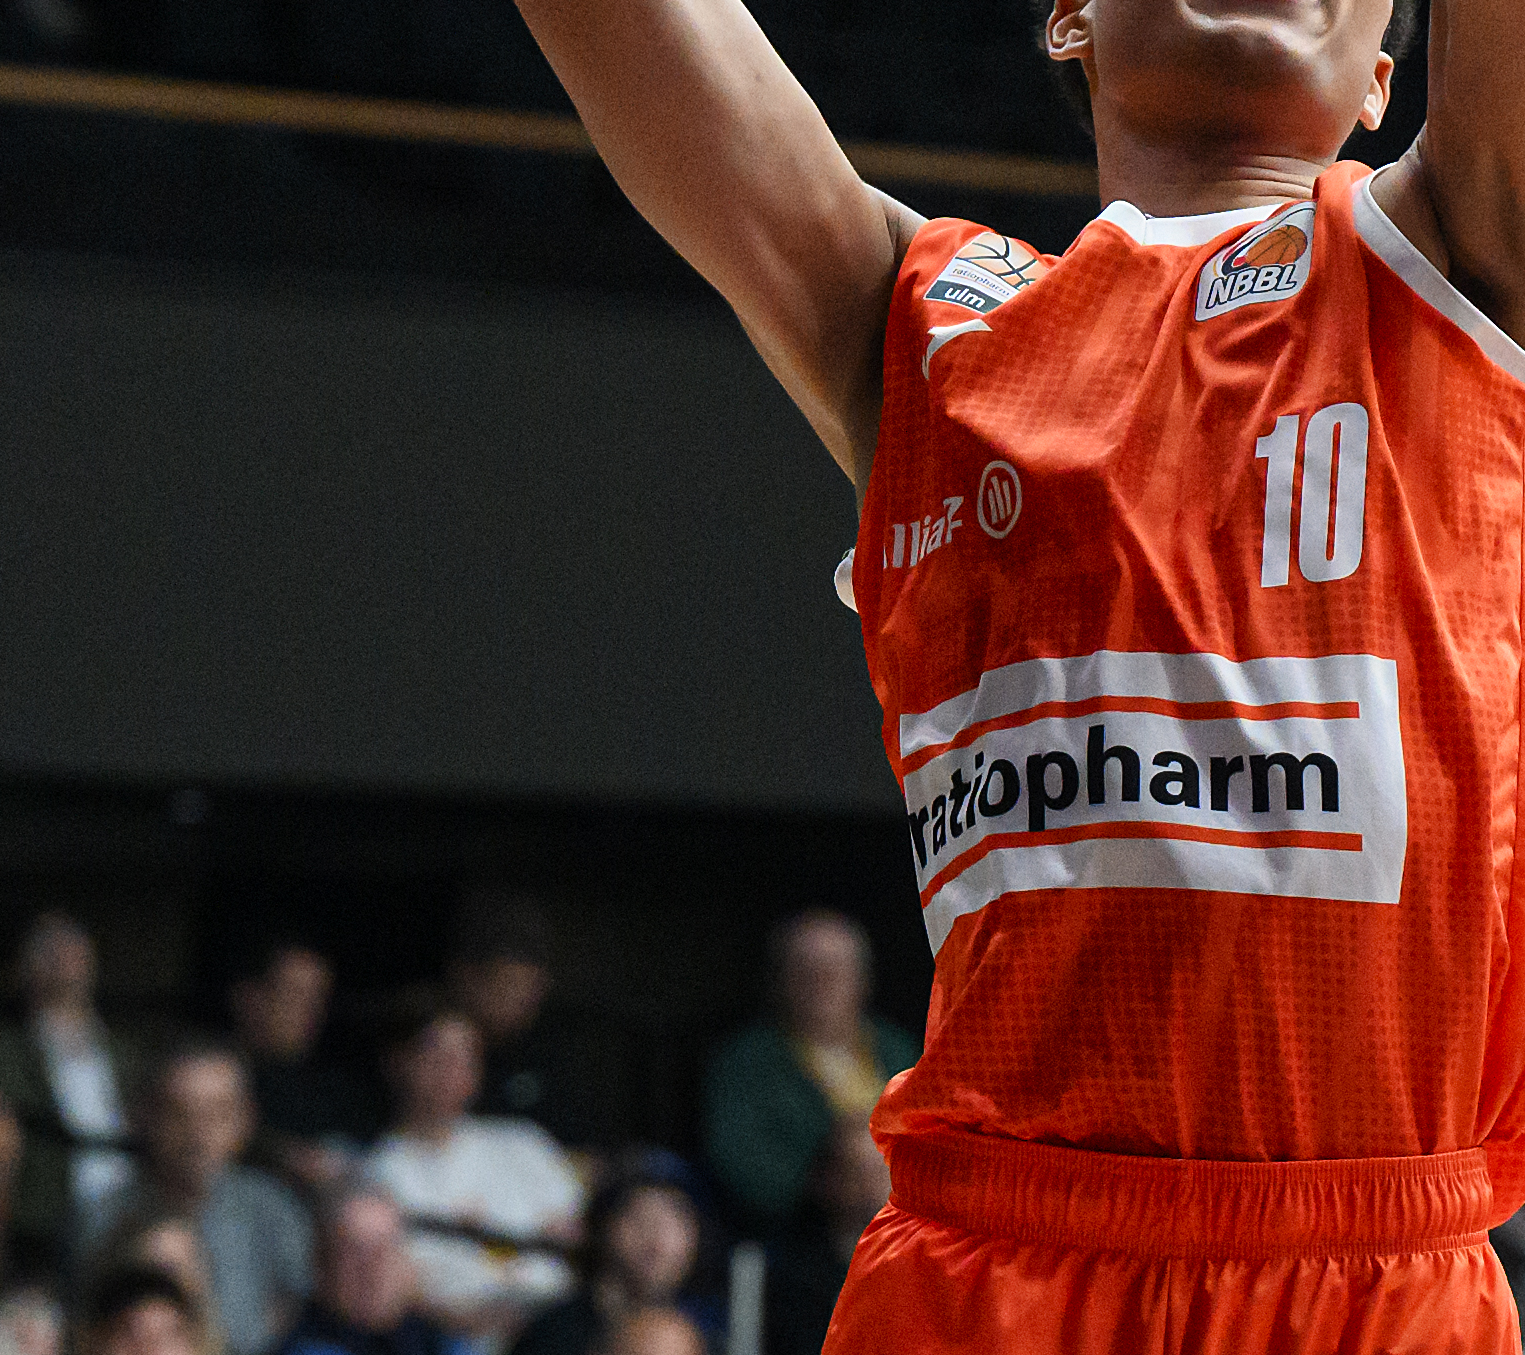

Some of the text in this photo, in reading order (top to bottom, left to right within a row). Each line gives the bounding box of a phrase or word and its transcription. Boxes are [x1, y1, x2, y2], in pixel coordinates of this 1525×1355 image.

[944, 287, 986, 309] ulm
[1205, 263, 1298, 310] NBBL
[1255, 402, 1370, 588] 10
[908, 724, 1340, 870] ratiopharm
